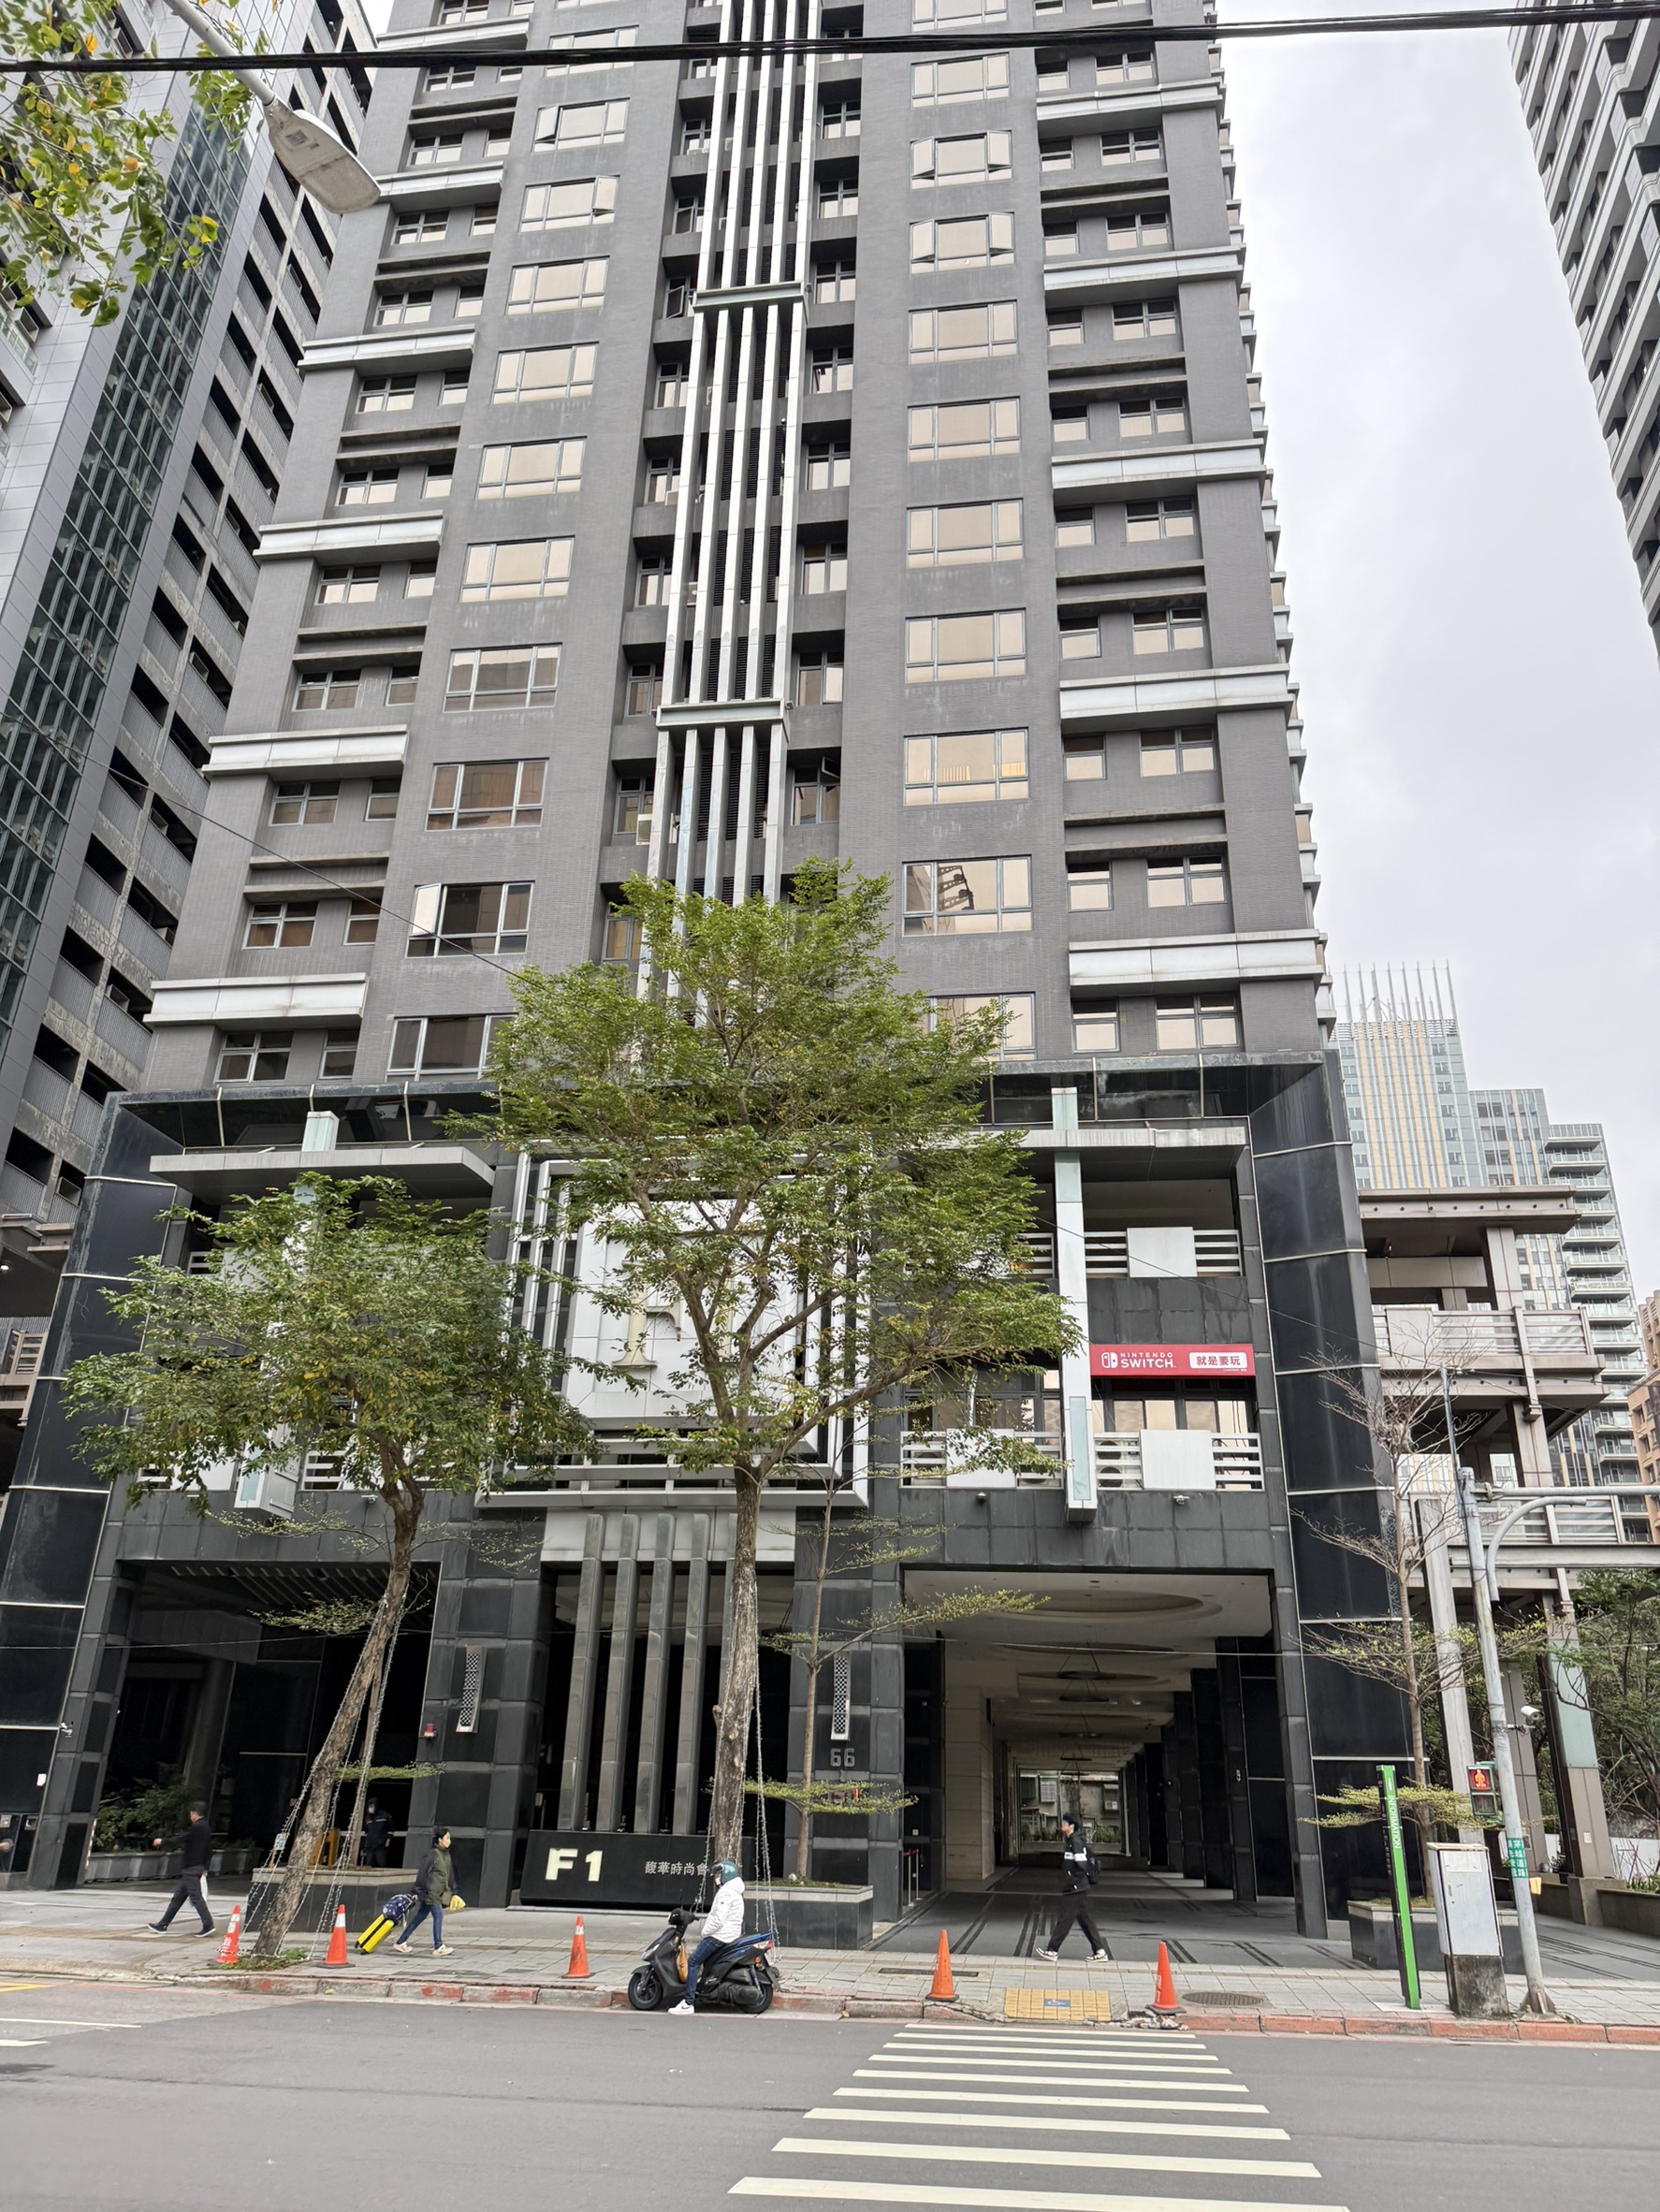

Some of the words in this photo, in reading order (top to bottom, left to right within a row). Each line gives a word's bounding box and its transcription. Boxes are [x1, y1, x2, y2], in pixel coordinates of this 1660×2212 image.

[1120, 1359, 1173, 1368] SWITCH
[1196, 1356, 1241, 1366] 就是要玩
[830, 1748, 855, 1767] 66
[1388, 1795, 1402, 1849] INFORMATION
[545, 1847, 604, 1882] F1
